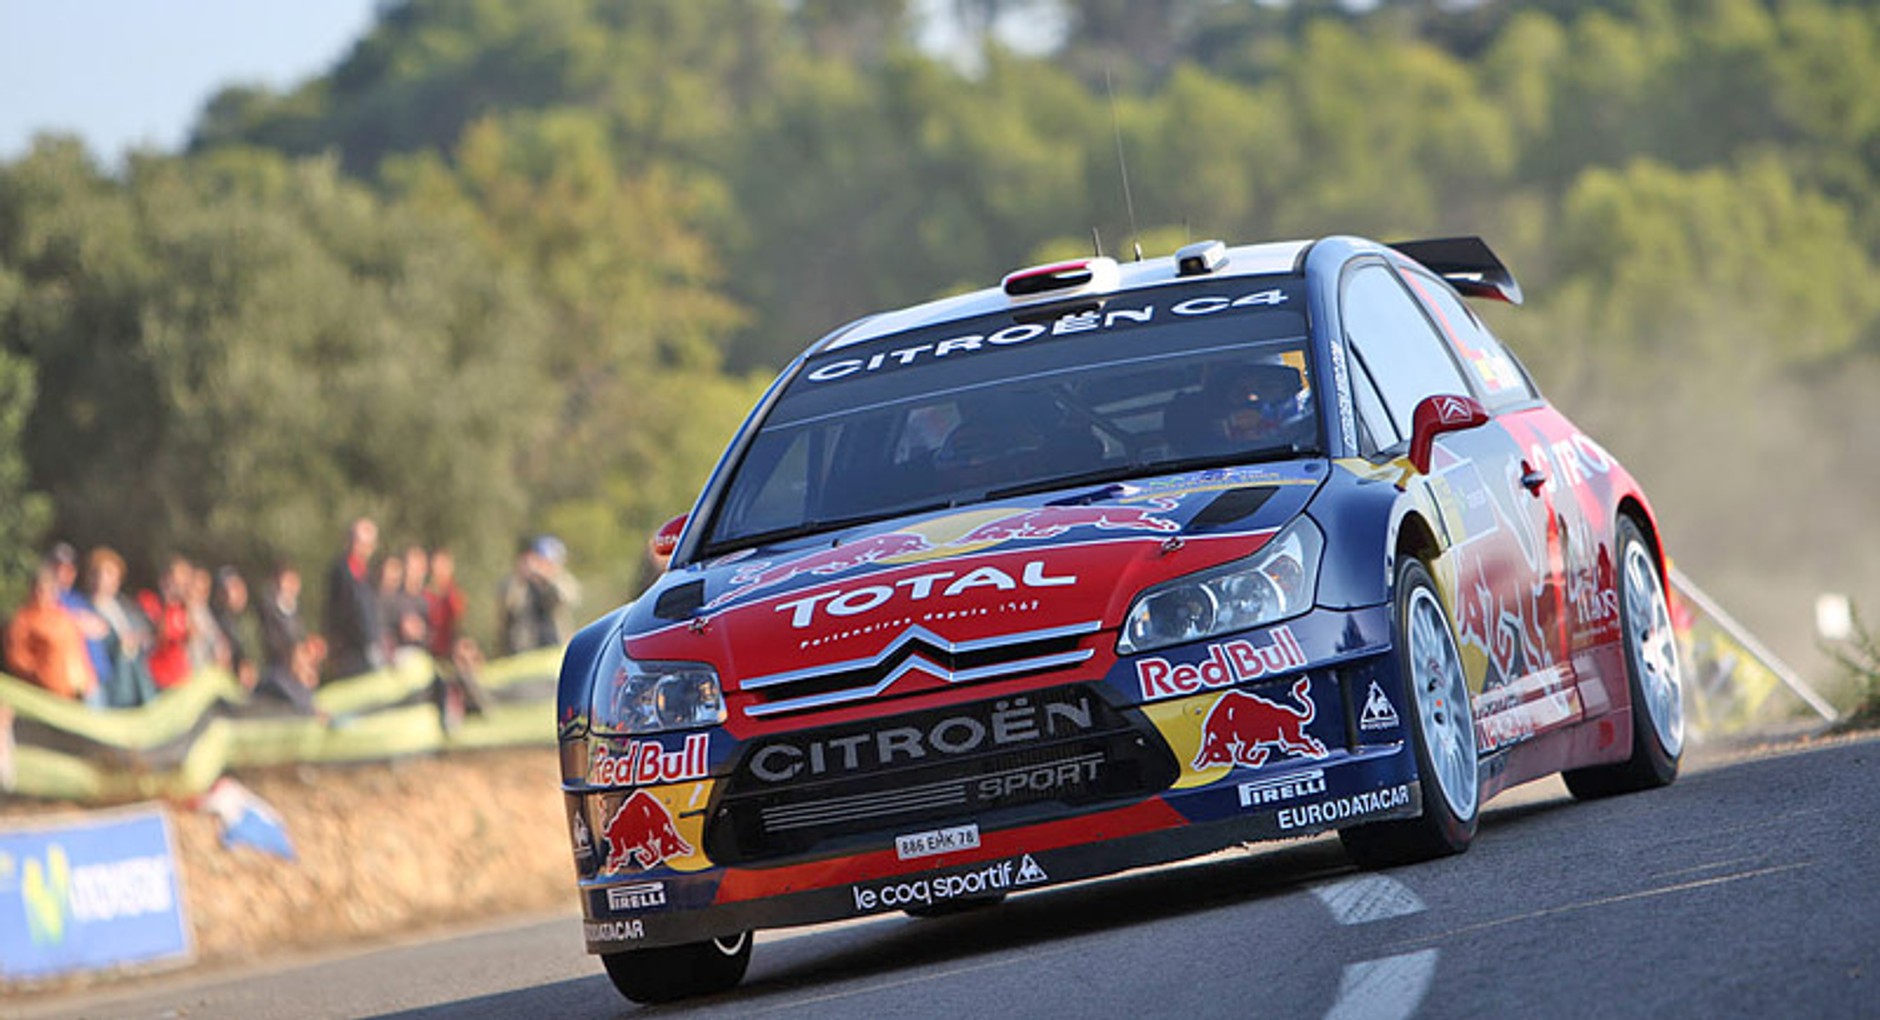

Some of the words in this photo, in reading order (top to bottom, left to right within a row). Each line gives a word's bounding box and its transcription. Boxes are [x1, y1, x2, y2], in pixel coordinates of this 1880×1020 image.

[808, 306, 1153, 382] CITROËN
[1170, 289, 1288, 315] C4
[775, 561, 1077, 628] TOTAL
[1138, 643, 1231, 700] Red
[1227, 625, 1307, 682] Bull
[637, 733, 709, 784] Bull
[749, 698, 1092, 782] CITROËN
[978, 758, 1104, 800] SPORT
[1239, 769, 1326, 807] PIRELLI
[1278, 785, 1409, 829] EURODATACAR
[607, 882, 666, 911] PIRELLI
[852, 885, 878, 909] le
[880, 880, 933, 905] coq
[933, 860, 1012, 898] sportif
